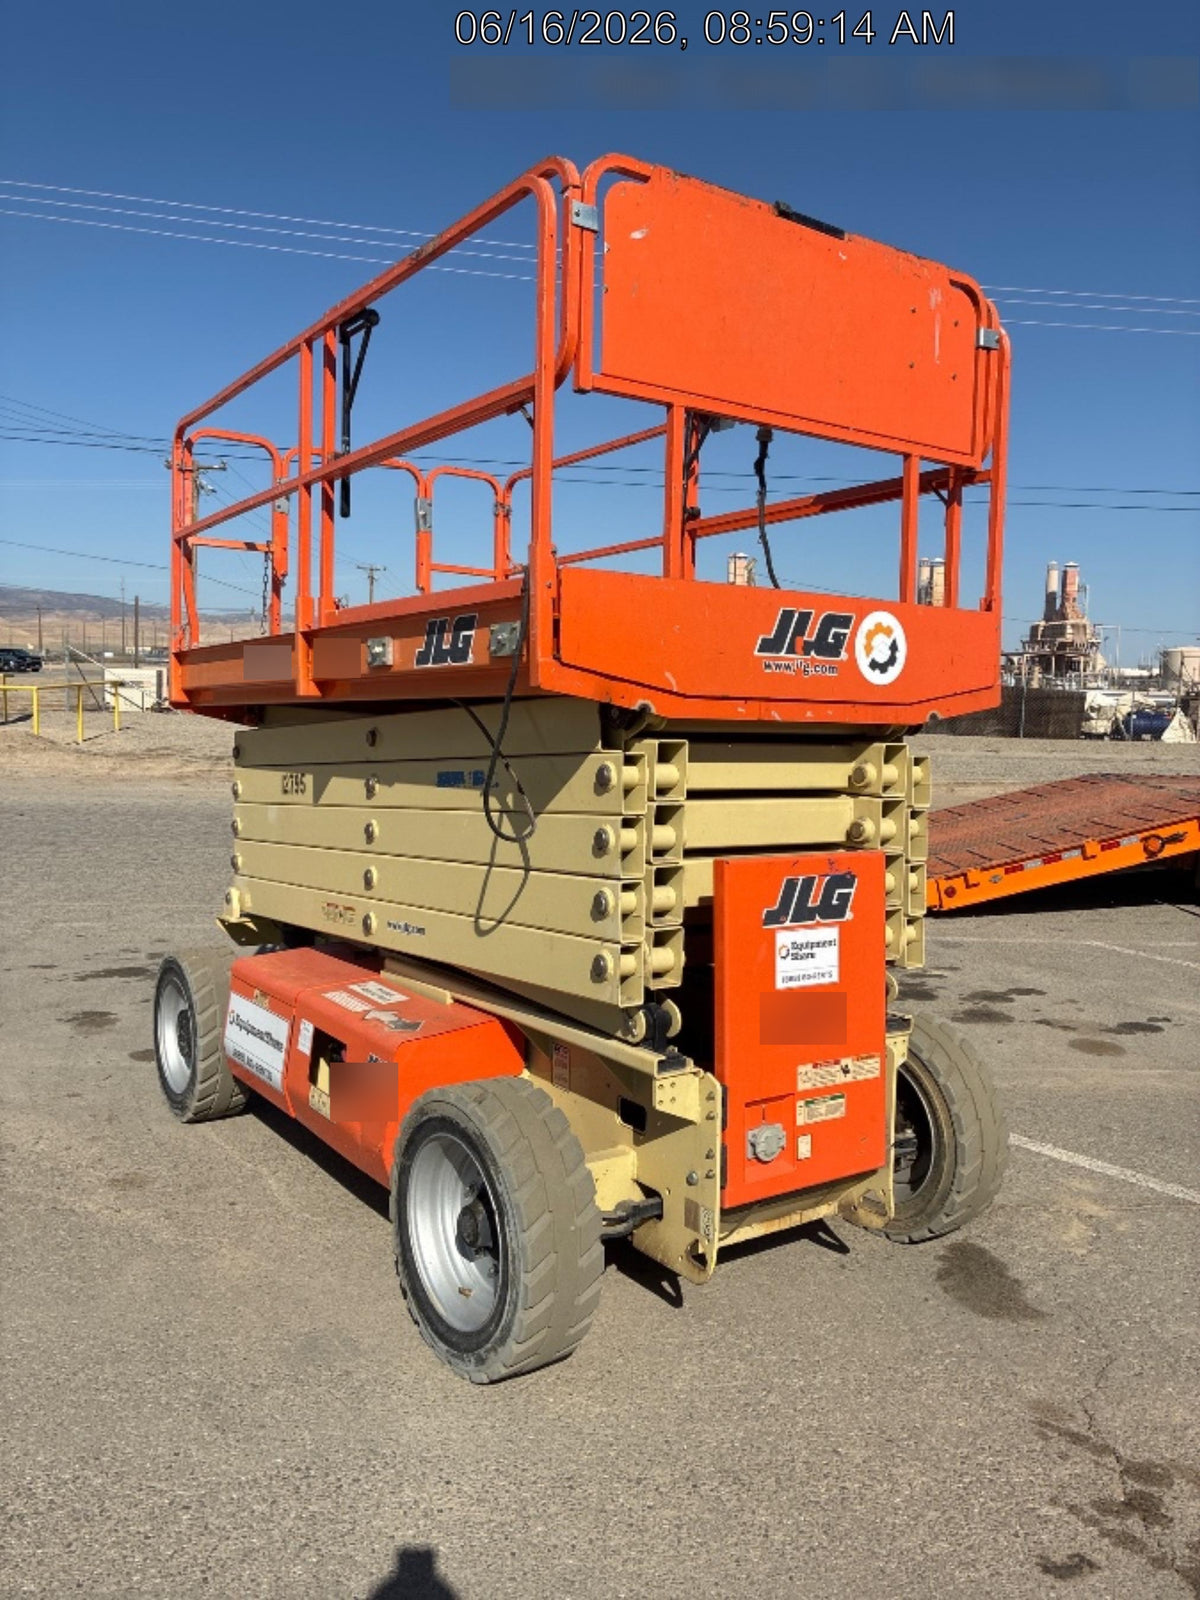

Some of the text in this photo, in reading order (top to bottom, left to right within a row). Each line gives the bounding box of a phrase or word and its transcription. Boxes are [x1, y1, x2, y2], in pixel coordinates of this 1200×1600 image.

[414, 613, 478, 669] JLG
[754, 608, 856, 661] JLG
[762, 874, 857, 928] JLG
